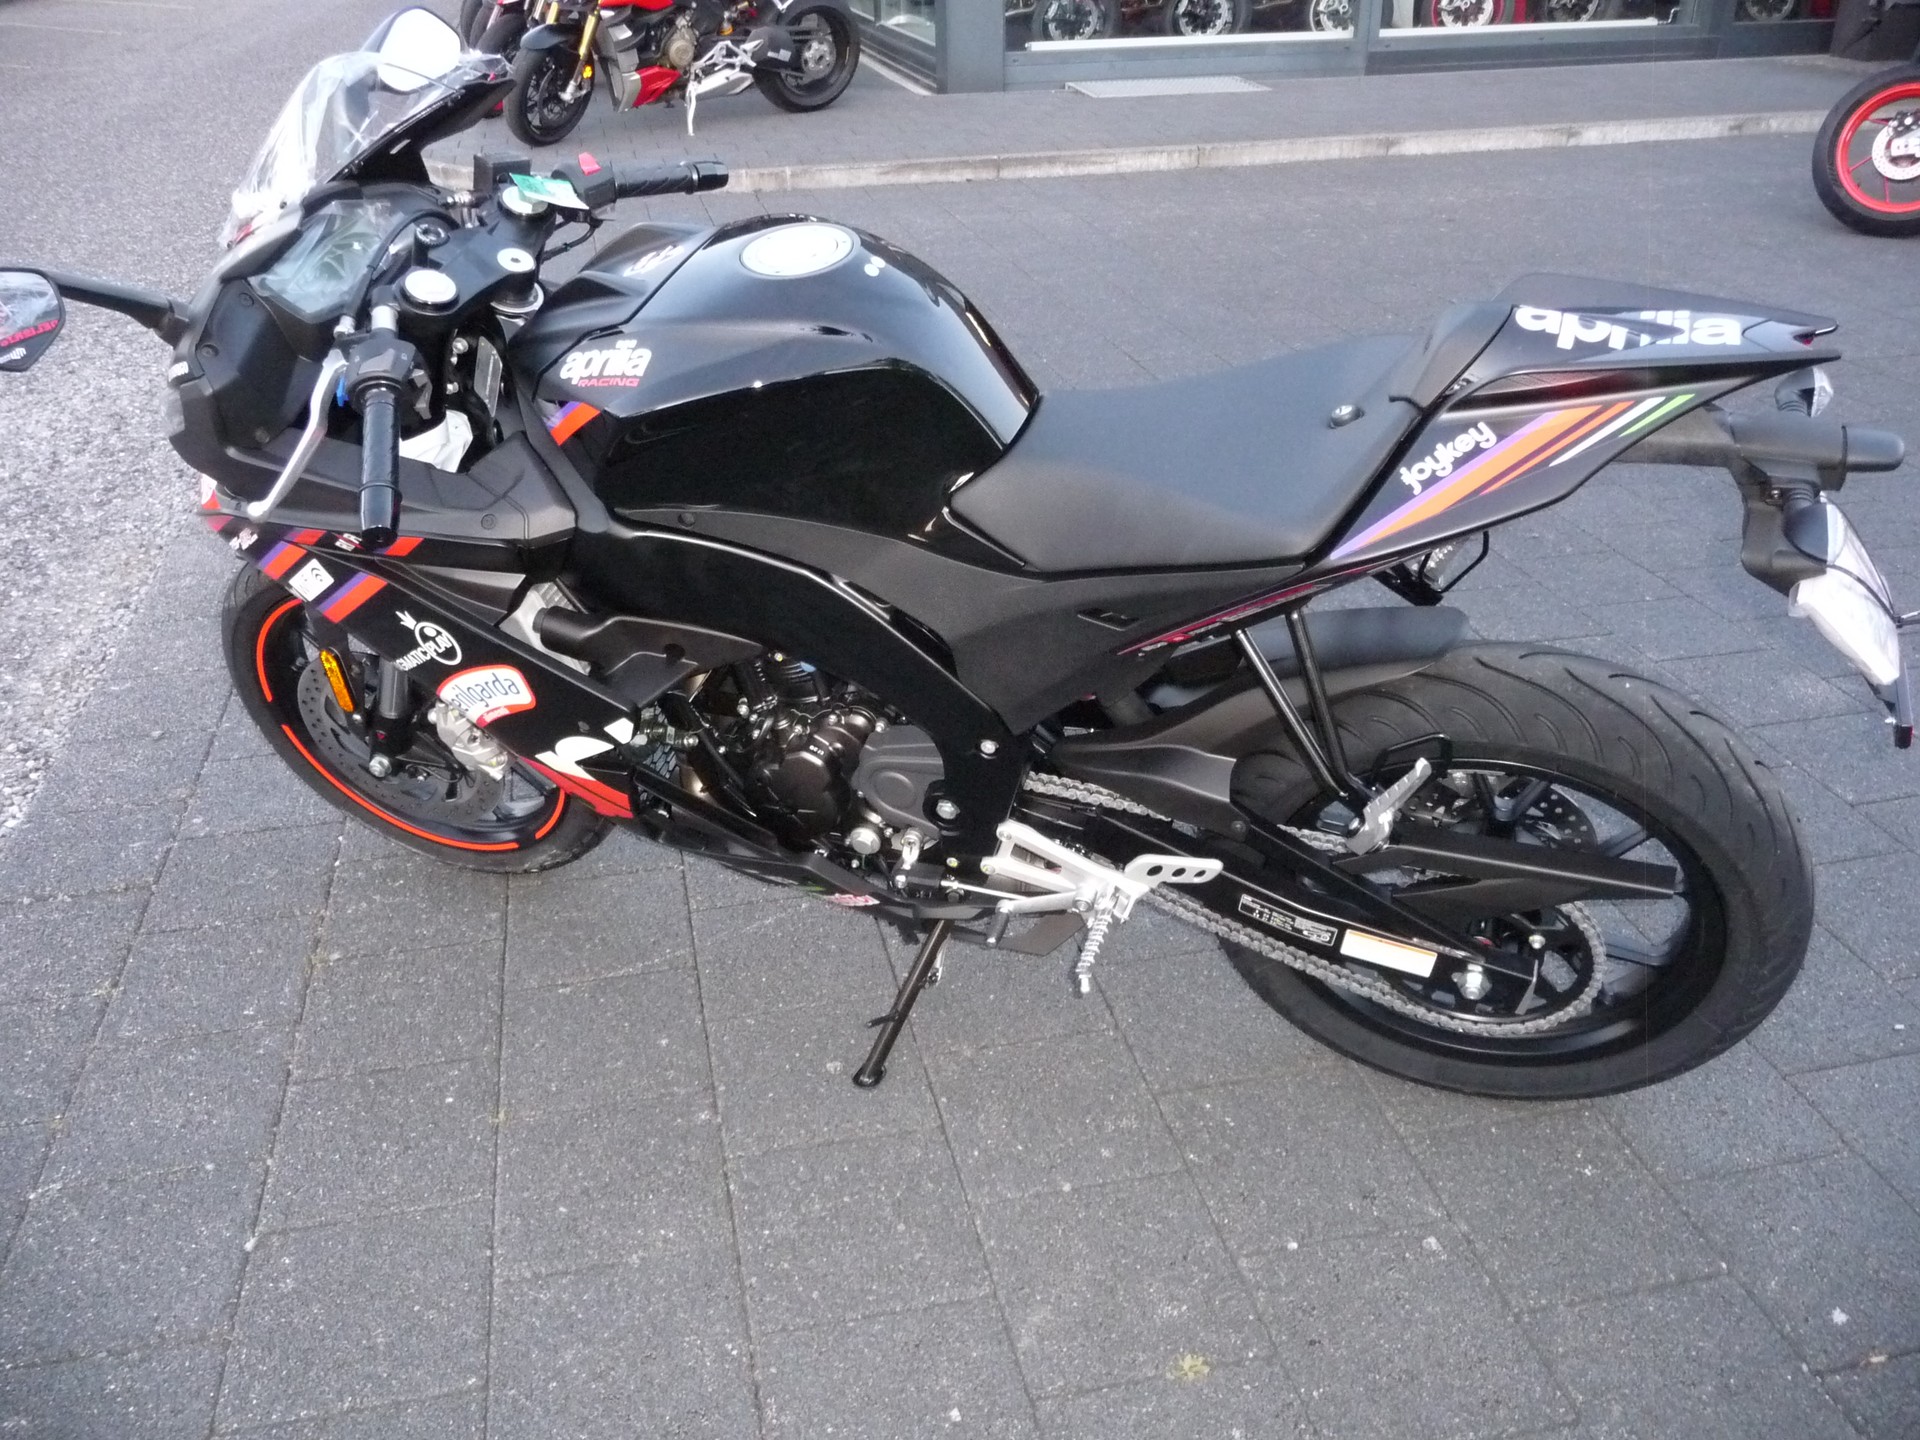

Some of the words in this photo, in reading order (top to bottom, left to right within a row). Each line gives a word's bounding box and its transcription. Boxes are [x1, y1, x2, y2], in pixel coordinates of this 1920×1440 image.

[1515, 304, 1742, 350] aprilia
[559, 339, 652, 385] aprilia
[578, 377, 640, 387] RACING
[1399, 421, 1497, 496] joykey
[394, 646, 432, 671] GMATIC
[424, 632, 453, 657] PLAY
